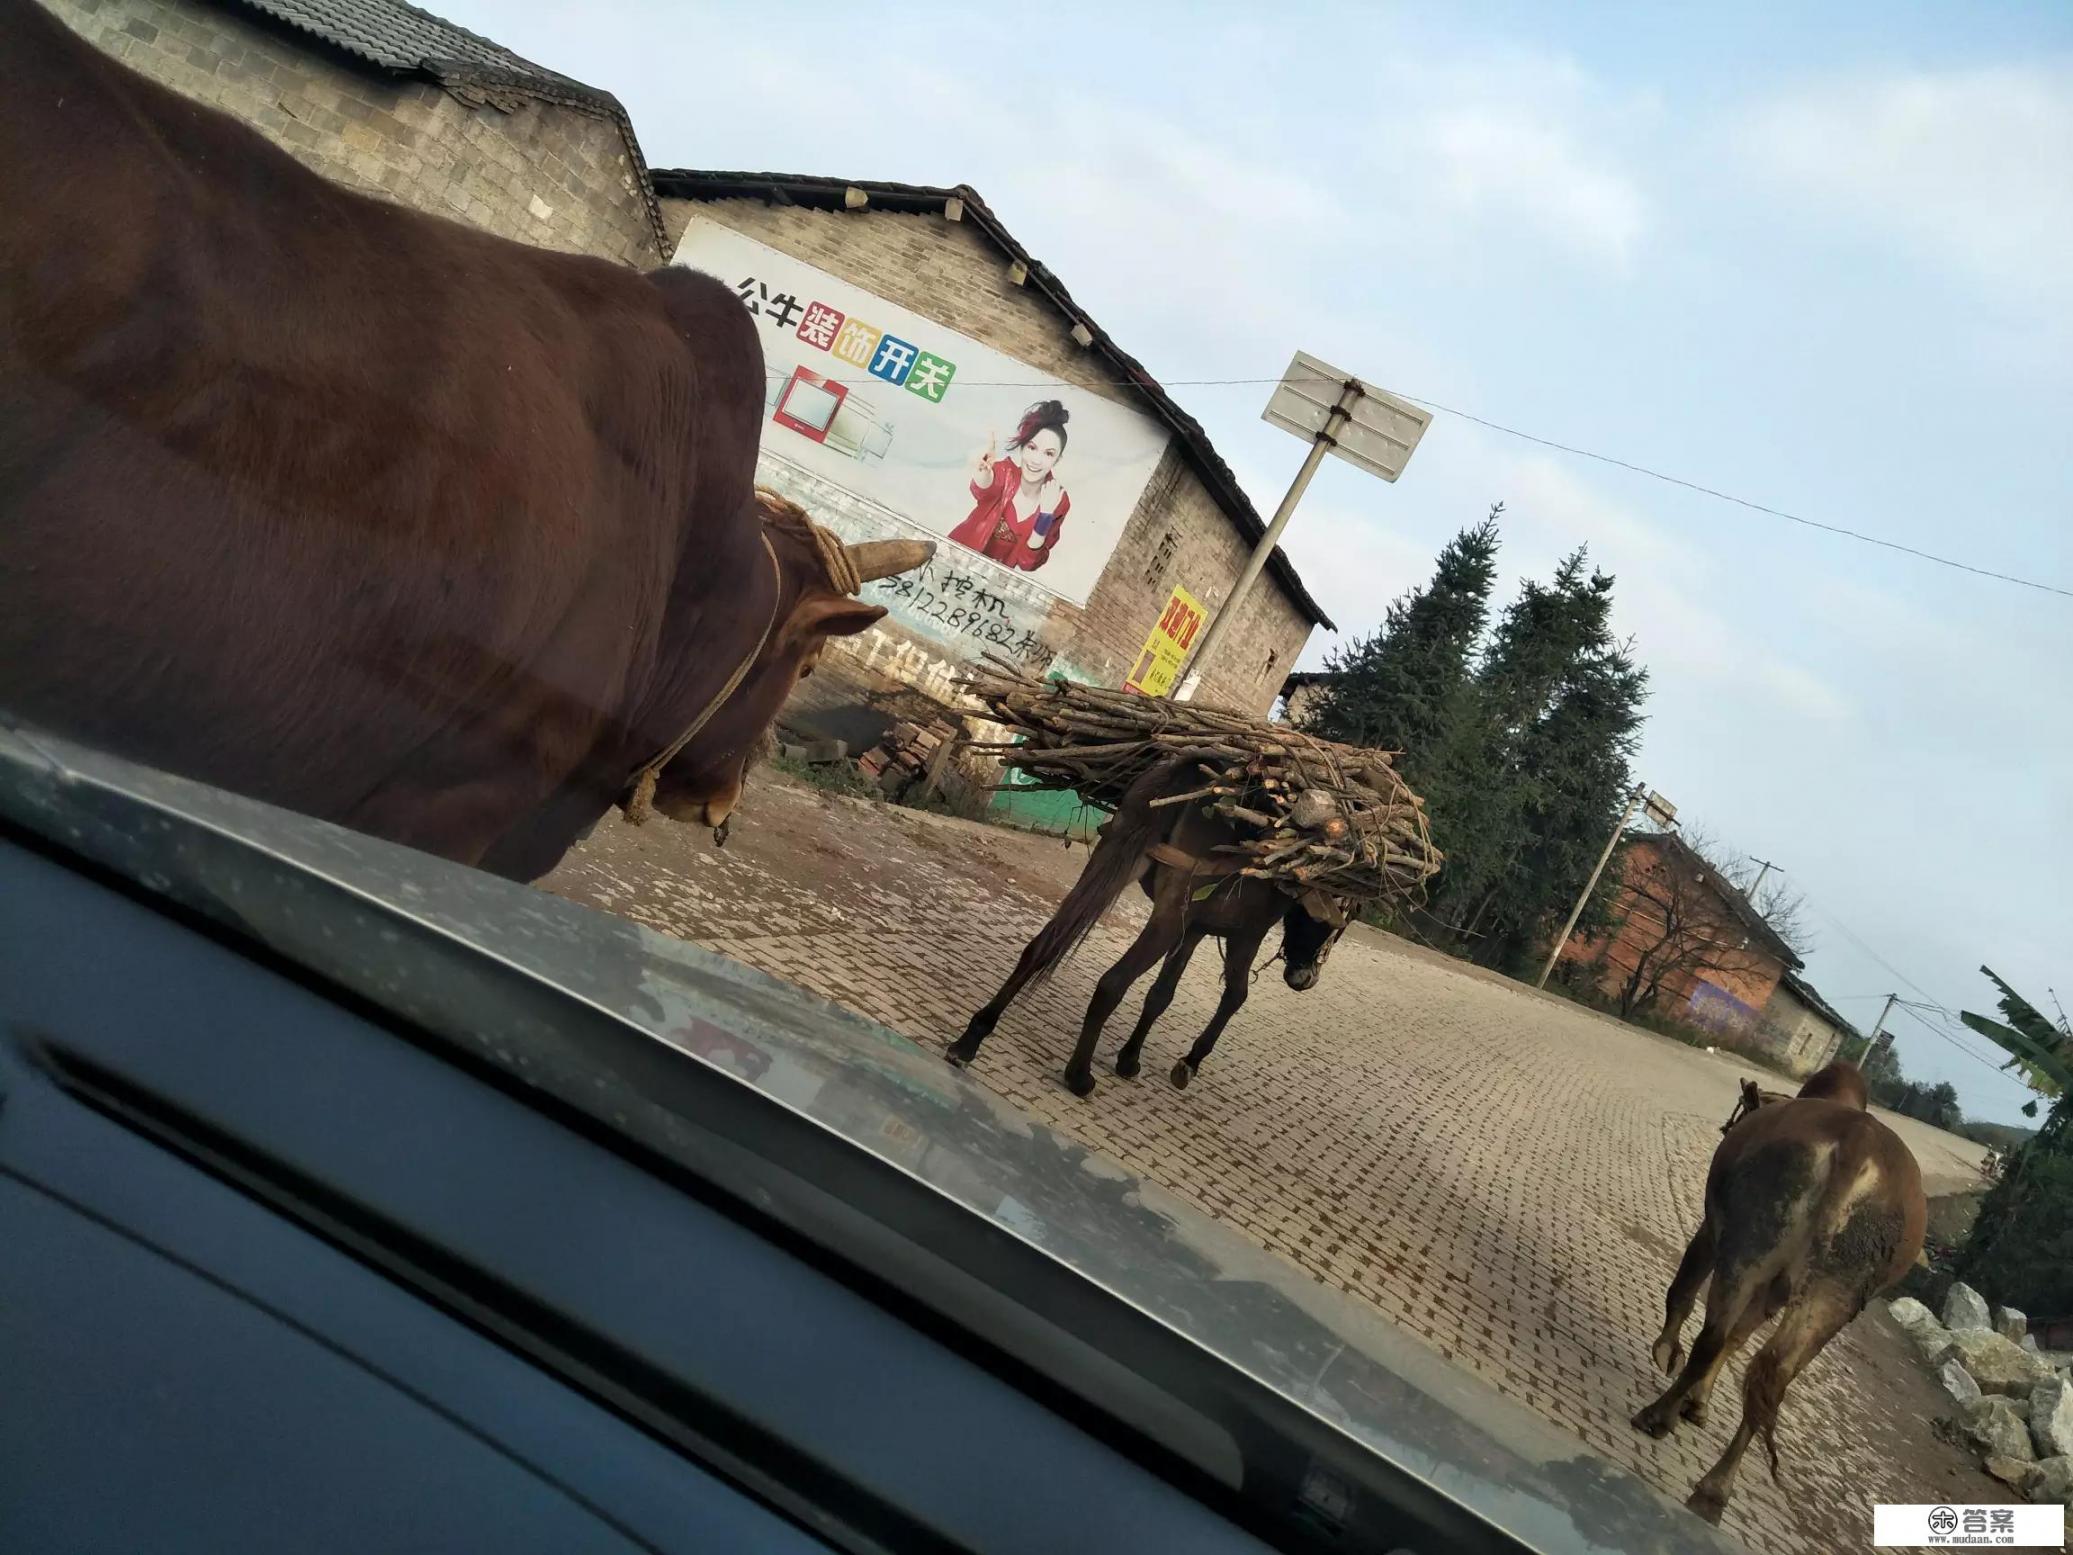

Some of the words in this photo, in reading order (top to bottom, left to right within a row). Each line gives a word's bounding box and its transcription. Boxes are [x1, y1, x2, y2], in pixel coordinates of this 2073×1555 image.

[737, 277, 955, 401] 公牛装饰开关
